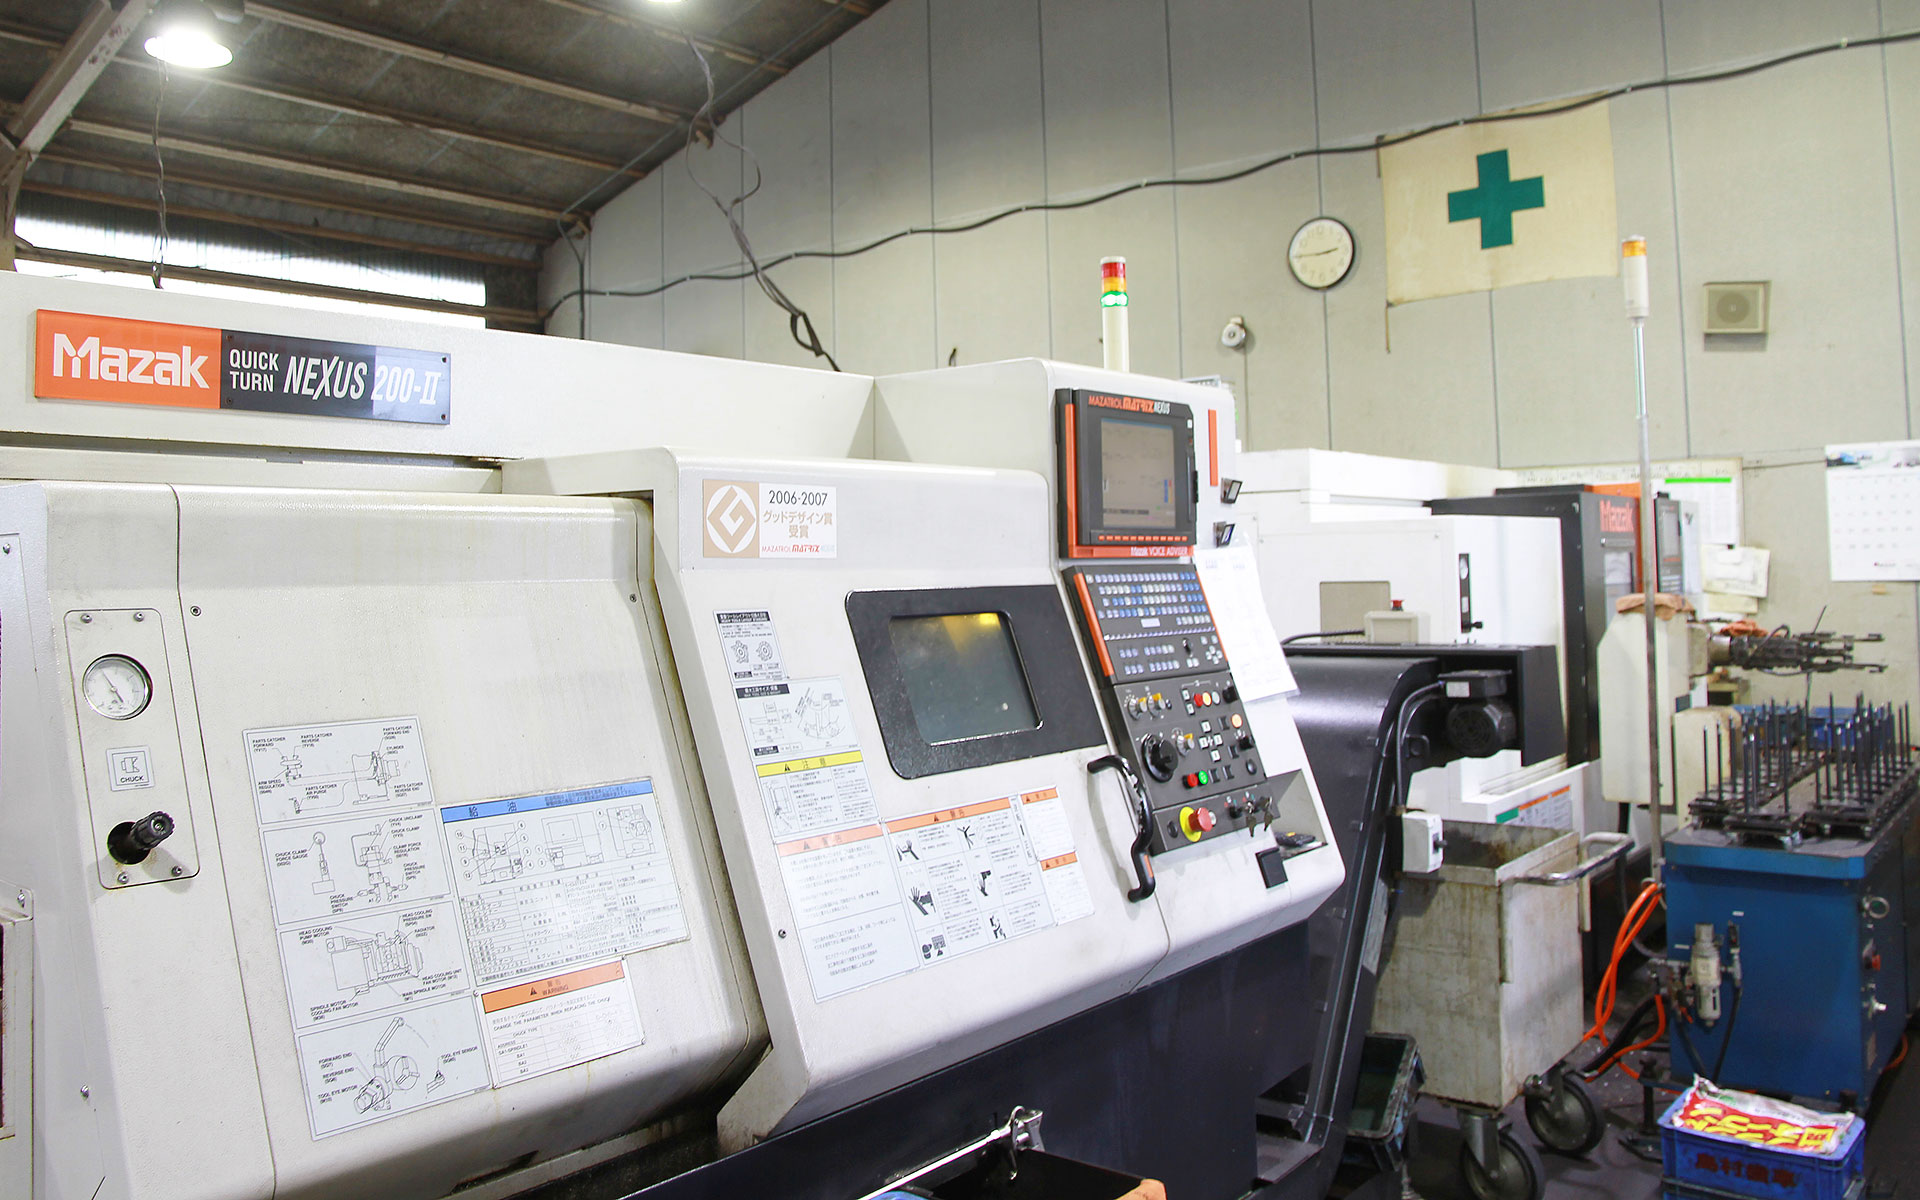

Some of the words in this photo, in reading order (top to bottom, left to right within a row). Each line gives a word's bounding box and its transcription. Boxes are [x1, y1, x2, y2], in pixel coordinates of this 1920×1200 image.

[53, 332, 210, 389] Mazak
[229, 348, 280, 371] QUICK
[283, 354, 369, 400] NEXUS
[229, 371, 275, 392] TURN
[768, 489, 828, 506] 2006-2007
[763, 510, 833, 525] グッドデザイン賞
[1600, 499, 1634, 532] Mazak
[542, 985, 569, 996] WARNING
[329, 999, 347, 1008] MOTOR
[342, 1002, 359, 1010] MOTOR
[493, 1023, 512, 1031] CHANGE
[523, 1013, 549, 1024] PARAMETER
[564, 1003, 587, 1014] REPLACING
[318, 1054, 343, 1065] FORWARD
[342, 1051, 353, 1060] END
[440, 1052, 452, 1060] TOOL
[322, 1069, 344, 1080] REVERSE
[344, 1066, 355, 1074] END
[318, 1092, 331, 1100] TOOL
[341, 1084, 358, 1094] MOTOR
